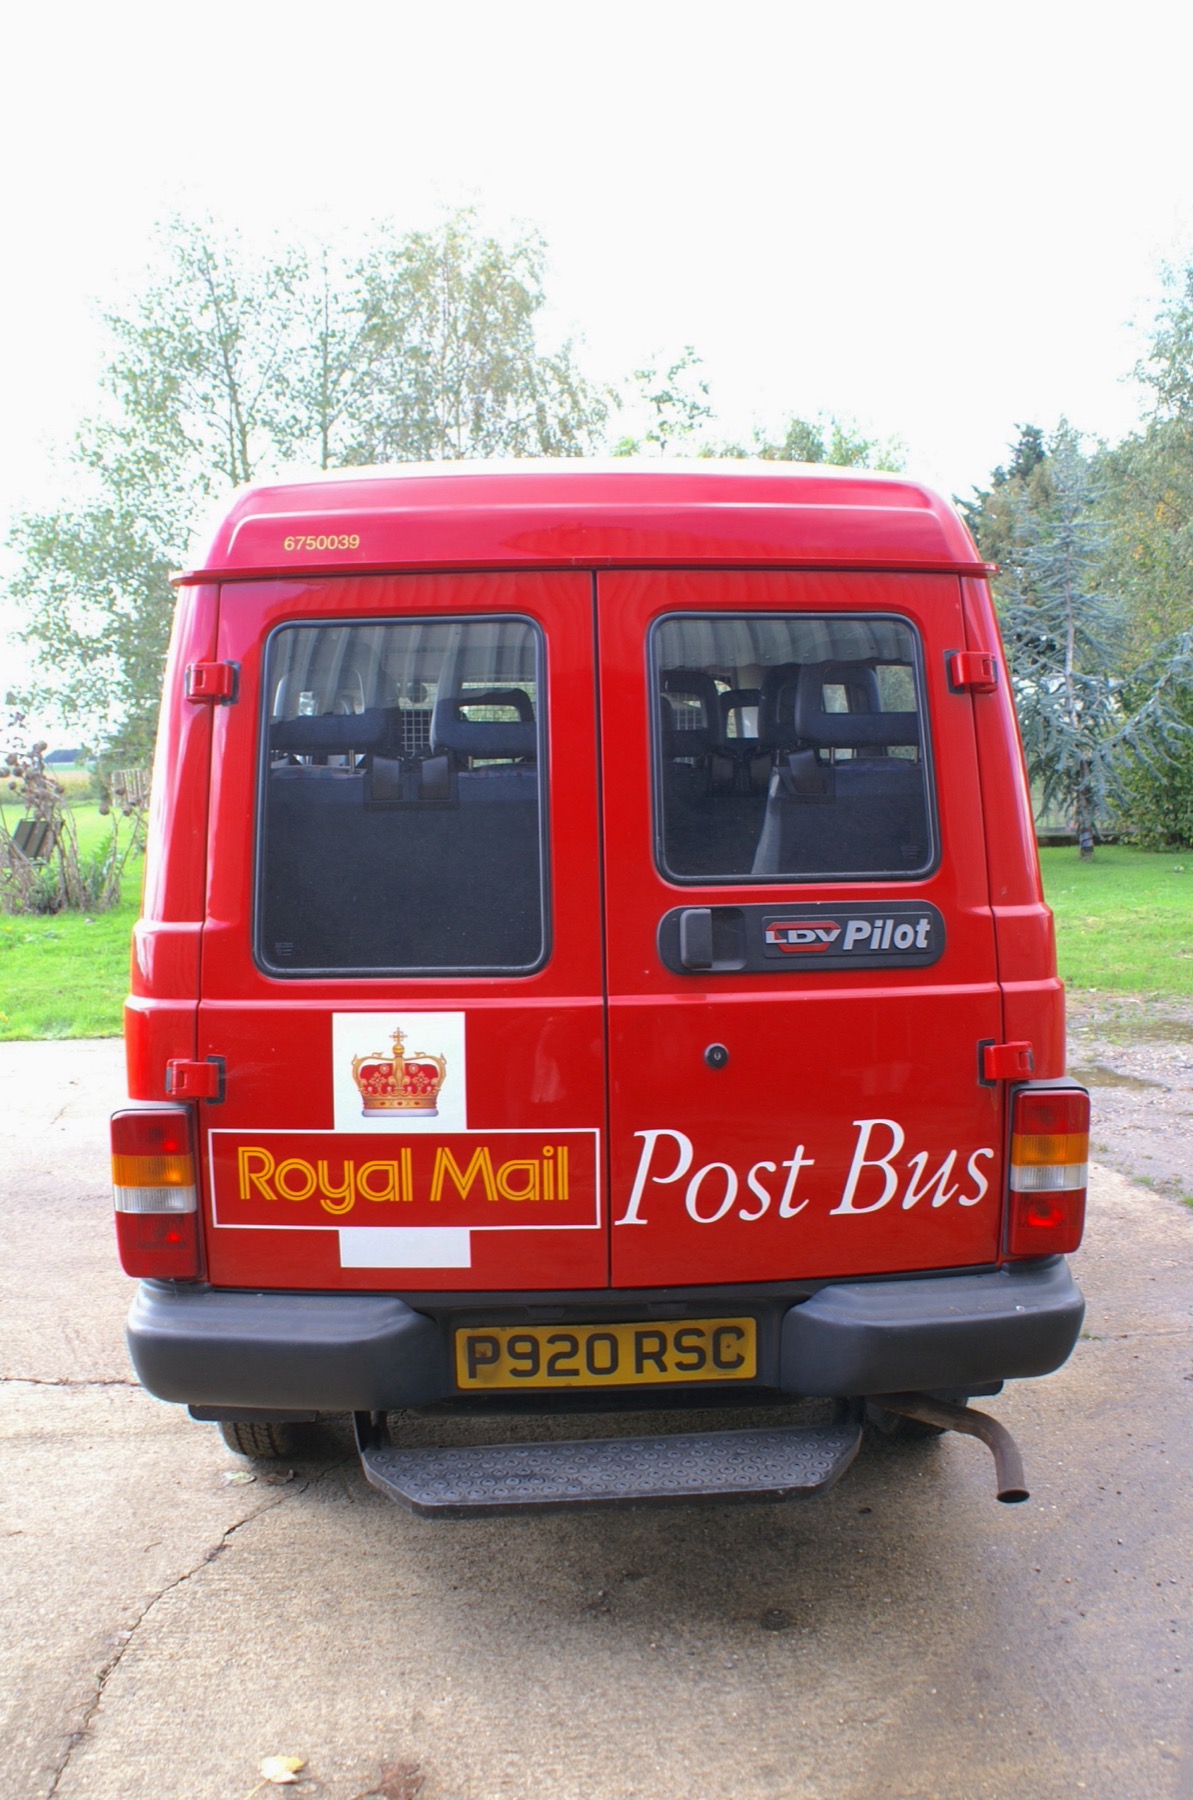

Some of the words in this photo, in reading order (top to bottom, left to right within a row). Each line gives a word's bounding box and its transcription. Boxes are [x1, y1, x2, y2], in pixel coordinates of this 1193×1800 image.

[284, 534, 360, 551] 6750039
[766, 929, 840, 944] LDV
[844, 919, 930, 949] Pilot
[238, 1147, 413, 1214] Royal
[430, 1146, 569, 1201] Mail
[615, 1129, 814, 1226] Post
[830, 1119, 994, 1216] Bus
[467, 1333, 619, 1379] P920
[636, 1327, 745, 1373] RSC
